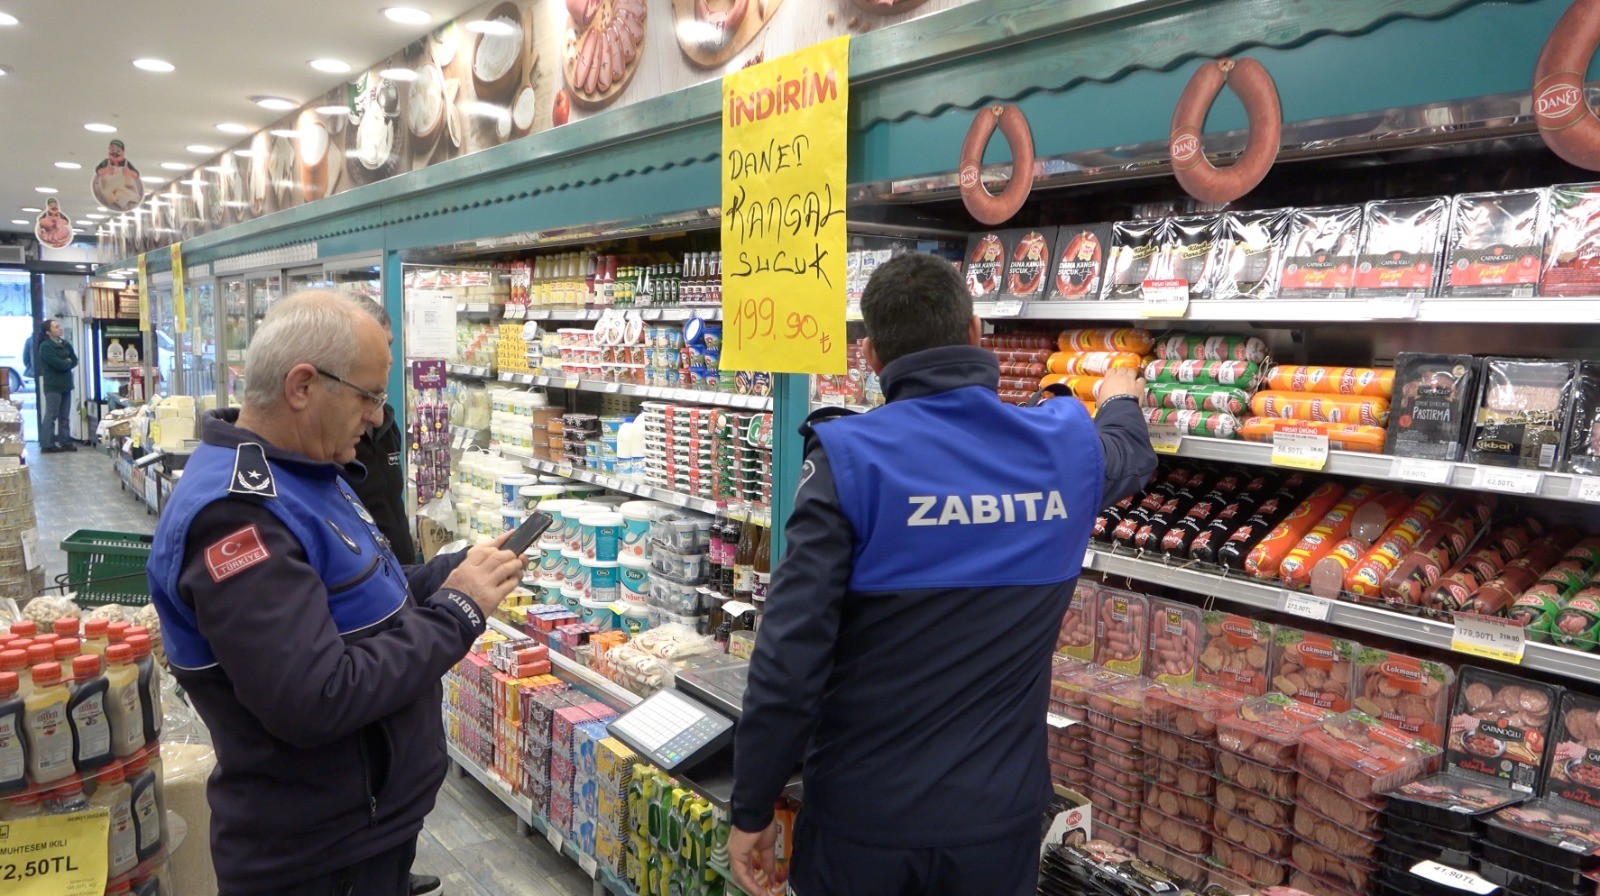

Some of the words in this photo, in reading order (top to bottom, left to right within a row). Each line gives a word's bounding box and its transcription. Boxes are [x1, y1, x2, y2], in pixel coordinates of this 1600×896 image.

[729, 67, 837, 127] İNDİRİM
[1537, 90, 1579, 112] DANET
[1173, 138, 1198, 156] DANET
[726, 183, 845, 245] KANGAL
[730, 243, 832, 289] SUCUK
[1413, 406, 1450, 422] PASTIRMA
[907, 490, 1068, 526] ZABITA
[220, 551, 262, 573] TÜRKİYE
[448, 593, 480, 627] ZABITA
[0, 842, 47, 855] MUHTESEM
[0, 856, 79, 881] 2,50TL
